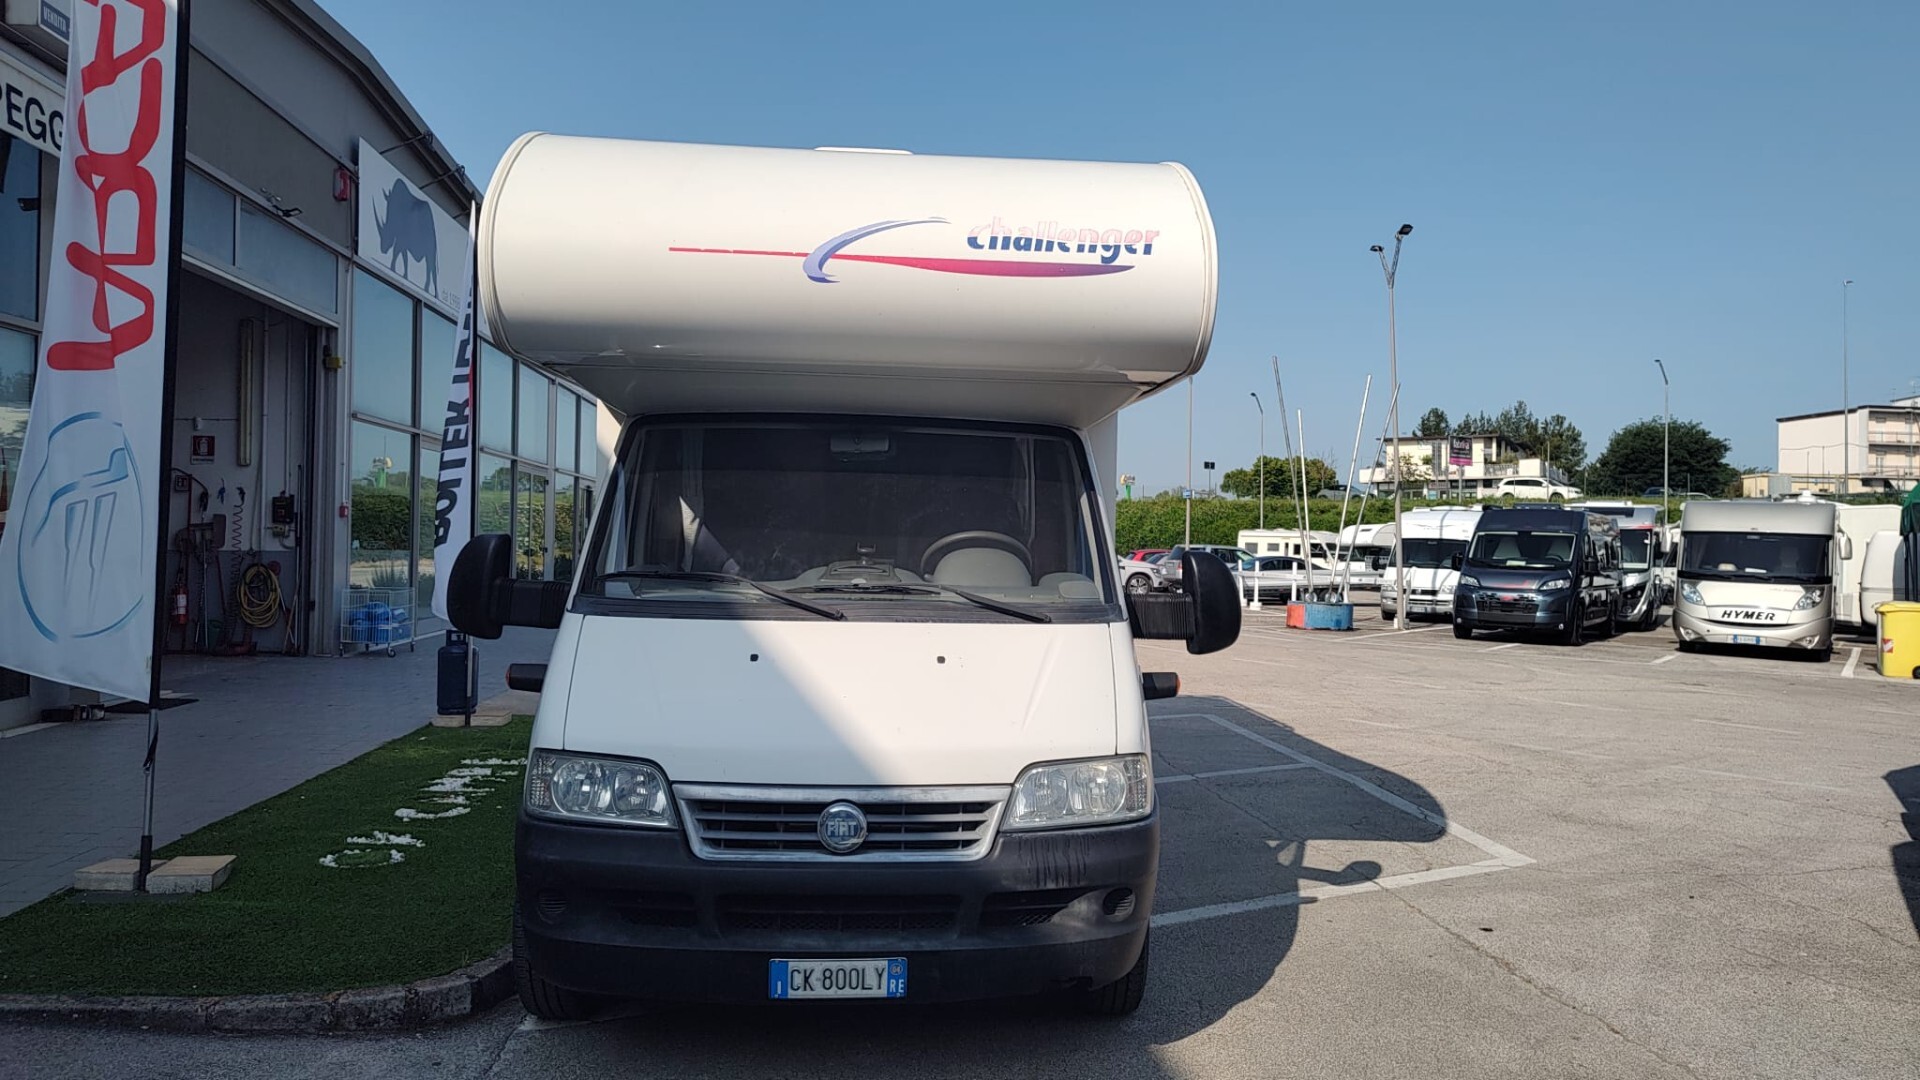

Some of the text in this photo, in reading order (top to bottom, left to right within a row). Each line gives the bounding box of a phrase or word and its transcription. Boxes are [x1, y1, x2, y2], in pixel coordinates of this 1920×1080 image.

[967, 216, 1160, 264] challenger
[1721, 609, 1776, 621] HYMER
[826, 820, 857, 837] FIAT
[889, 979, 905, 993] RE
